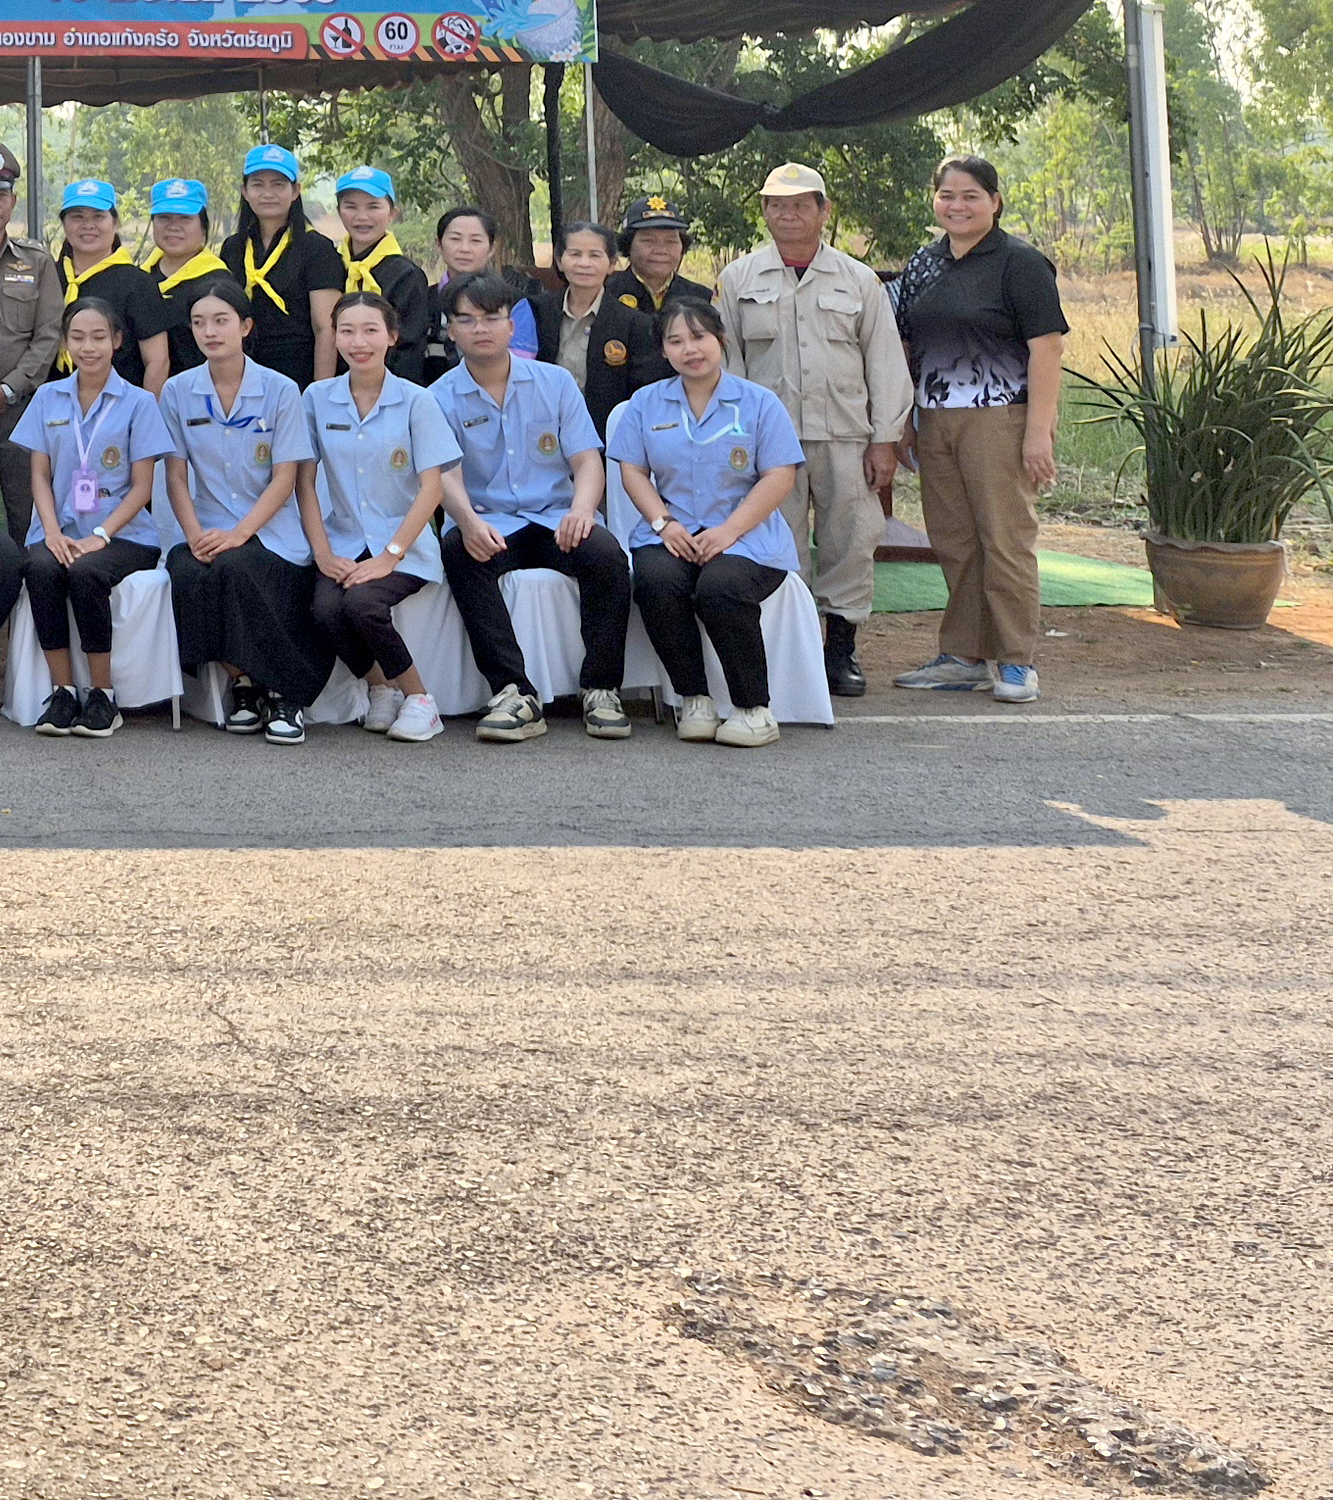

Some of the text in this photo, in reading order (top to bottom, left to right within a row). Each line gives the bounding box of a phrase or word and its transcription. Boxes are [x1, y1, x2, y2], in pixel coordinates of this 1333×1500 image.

[63, 28, 179, 47] อำเภอแก้งคร้อ
[188, 29, 292, 52] จังหวัดชัยภูมิ
[385, 21, 408, 40] 60
